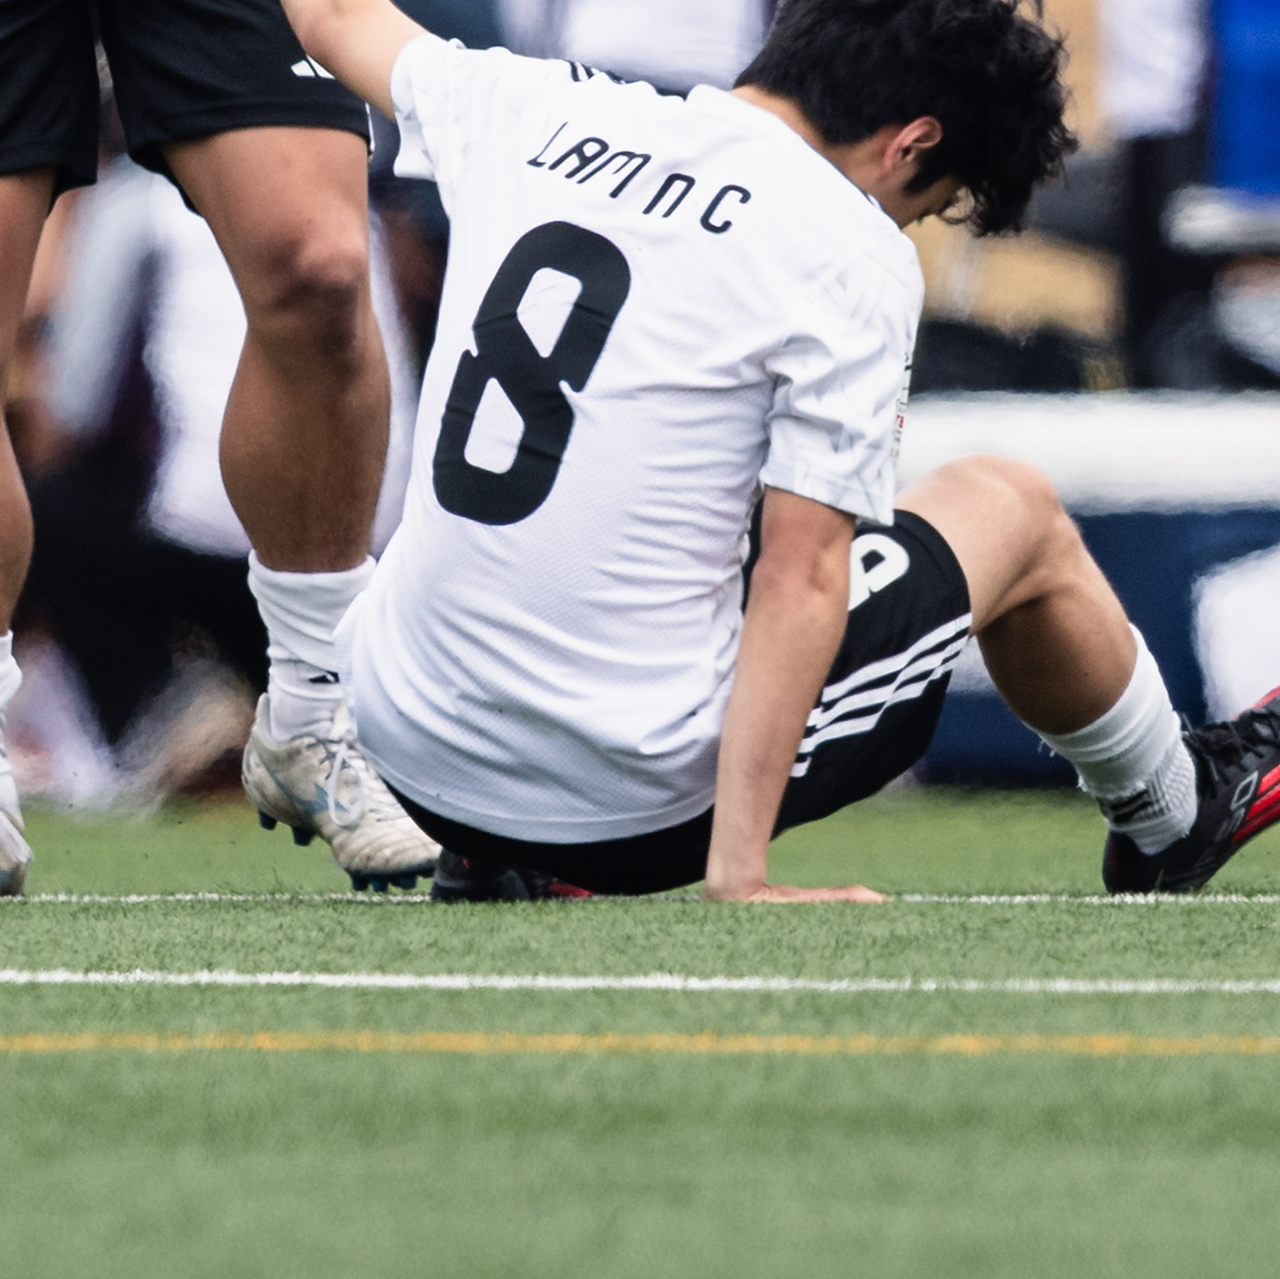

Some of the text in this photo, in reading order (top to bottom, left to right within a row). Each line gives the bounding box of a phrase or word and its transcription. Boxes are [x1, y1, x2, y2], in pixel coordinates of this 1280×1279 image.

[527, 121, 652, 199] LAM
[700, 185, 751, 234] C
[433, 221, 631, 526] 8
